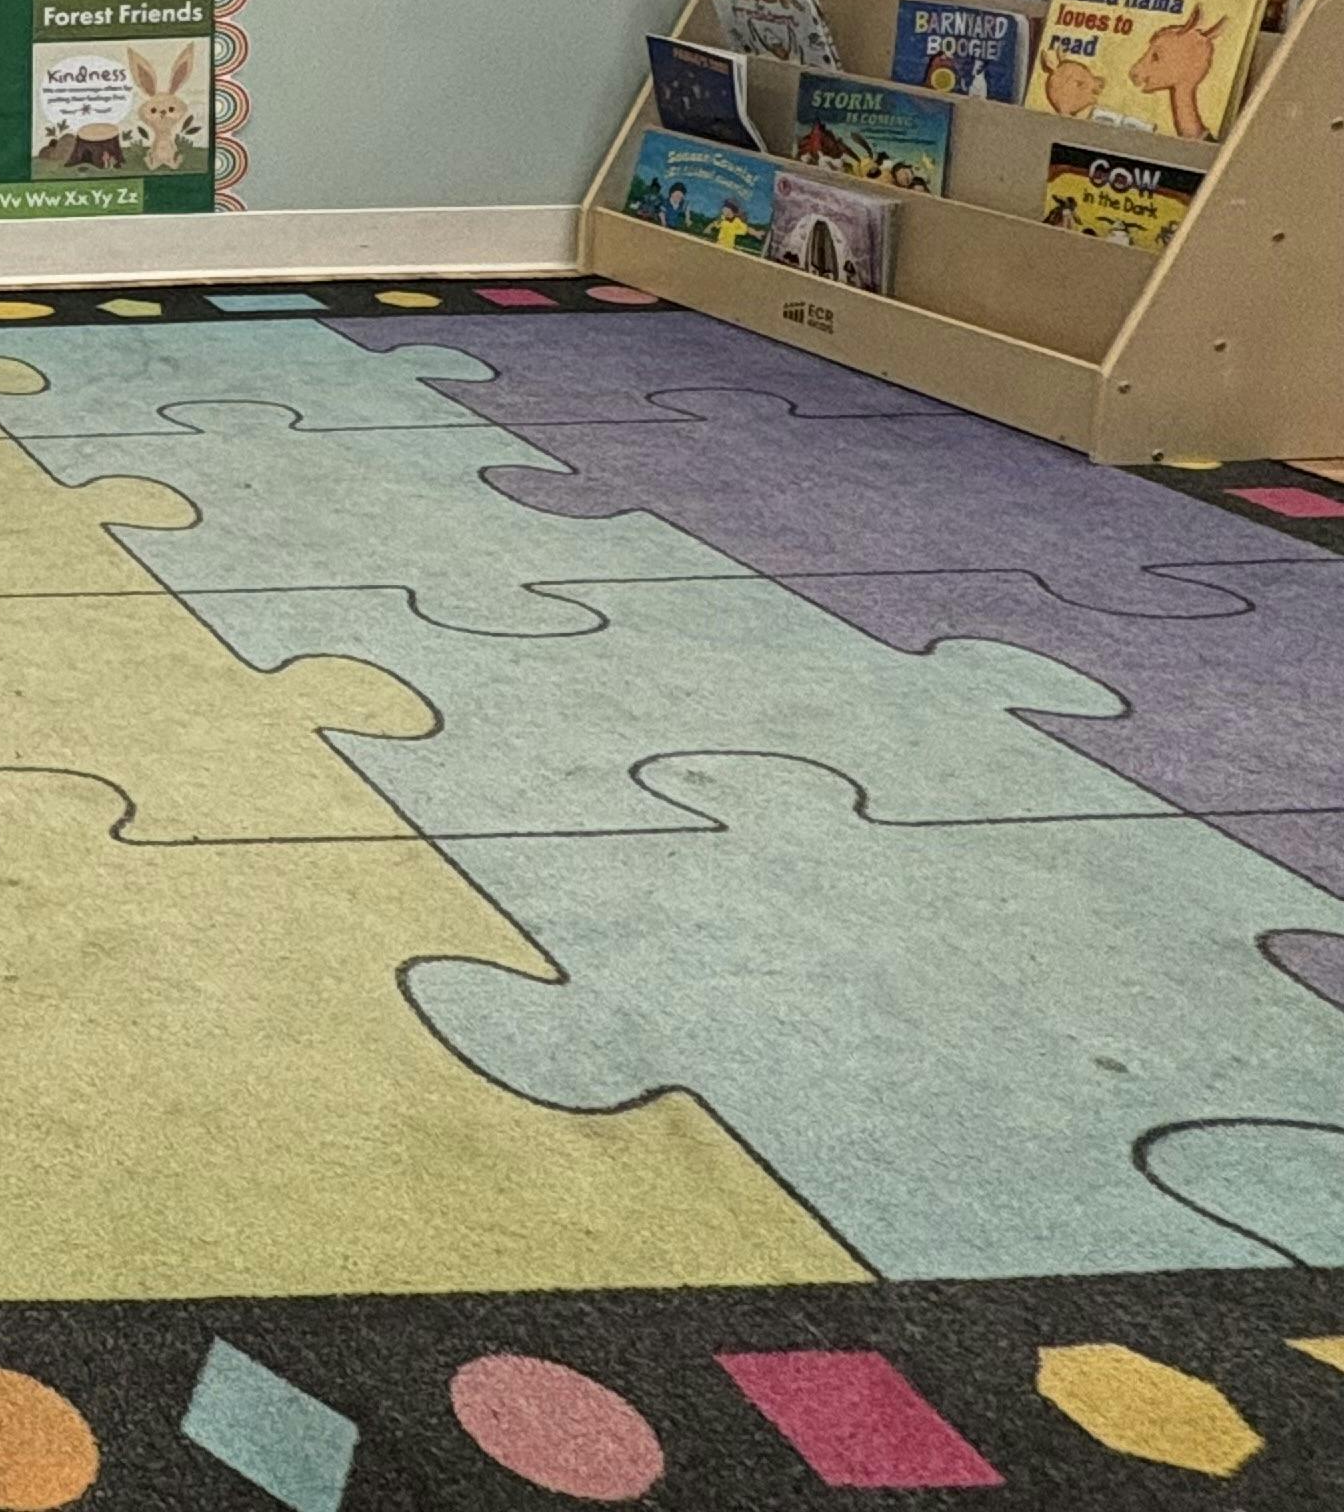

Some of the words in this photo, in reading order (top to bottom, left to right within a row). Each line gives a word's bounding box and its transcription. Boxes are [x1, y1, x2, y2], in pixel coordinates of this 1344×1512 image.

[43, 6, 113, 28] Forest
[118, 2, 204, 25] Friends
[914, 9, 1009, 40] BARNYARD
[1054, 3, 1110, 33] loves
[1112, 14, 1135, 36] to
[926, 35, 1002, 61] BOOGIE
[1047, 33, 1100, 58] read
[47, 65, 127, 84] Kindness
[812, 89, 885, 111] STORM
[1089, 159, 1162, 193] COW
[25, 192, 63, 208] Ww
[64, 191, 90, 208] Xx
[91, 189, 113, 211] Yy
[116, 188, 139, 205] Zz
[1083, 189, 1095, 205] in
[1098, 191, 1122, 211] the
[1123, 196, 1159, 220] Dark
